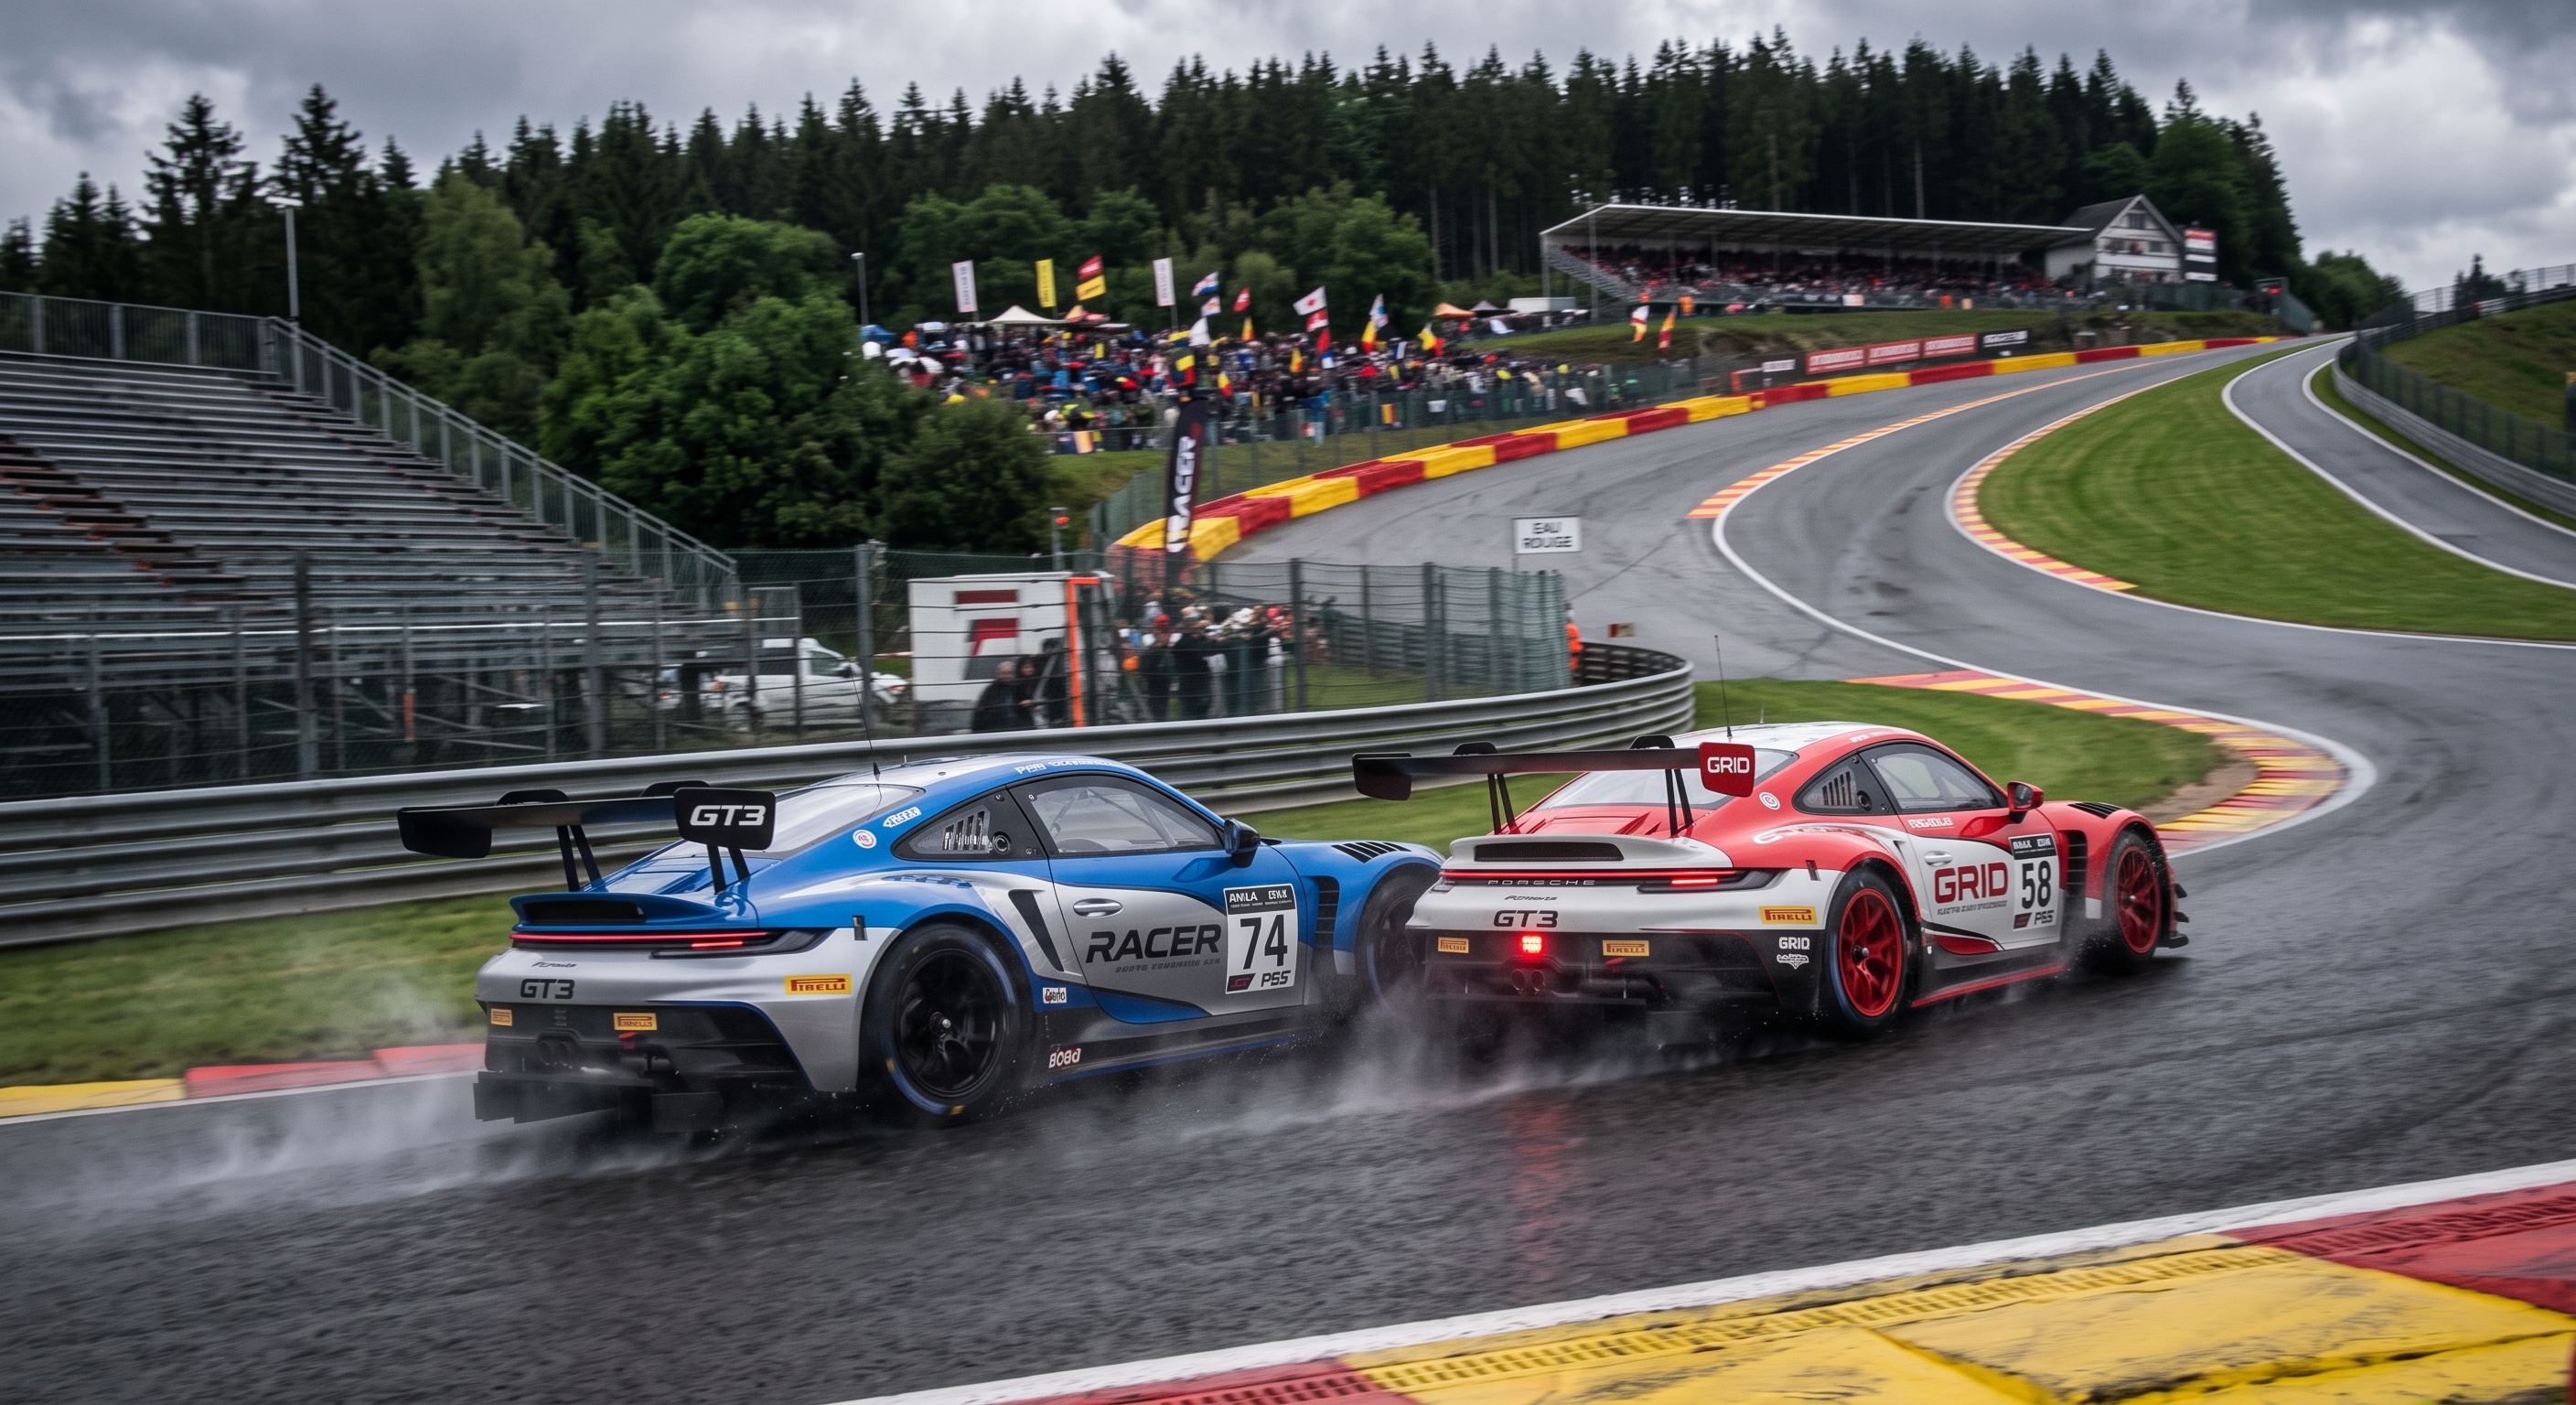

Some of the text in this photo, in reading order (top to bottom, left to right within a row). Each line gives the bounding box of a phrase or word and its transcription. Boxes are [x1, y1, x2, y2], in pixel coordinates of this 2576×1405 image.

[1532, 522, 1562, 534] EAU
[1521, 536, 1572, 549] ROUGE
[1707, 756, 1750, 774] GRID
[690, 805, 767, 826] GT3
[1934, 862, 2009, 905] GRID
[2021, 860, 2052, 909] 58
[1493, 910, 1559, 928] GT3
[1764, 909, 1812, 921] PIRELLI
[1085, 924, 1221, 964] RACER
[1240, 914, 1288, 970] 74
[520, 978, 575, 999] GT3
[790, 978, 846, 992] PIRELLI
